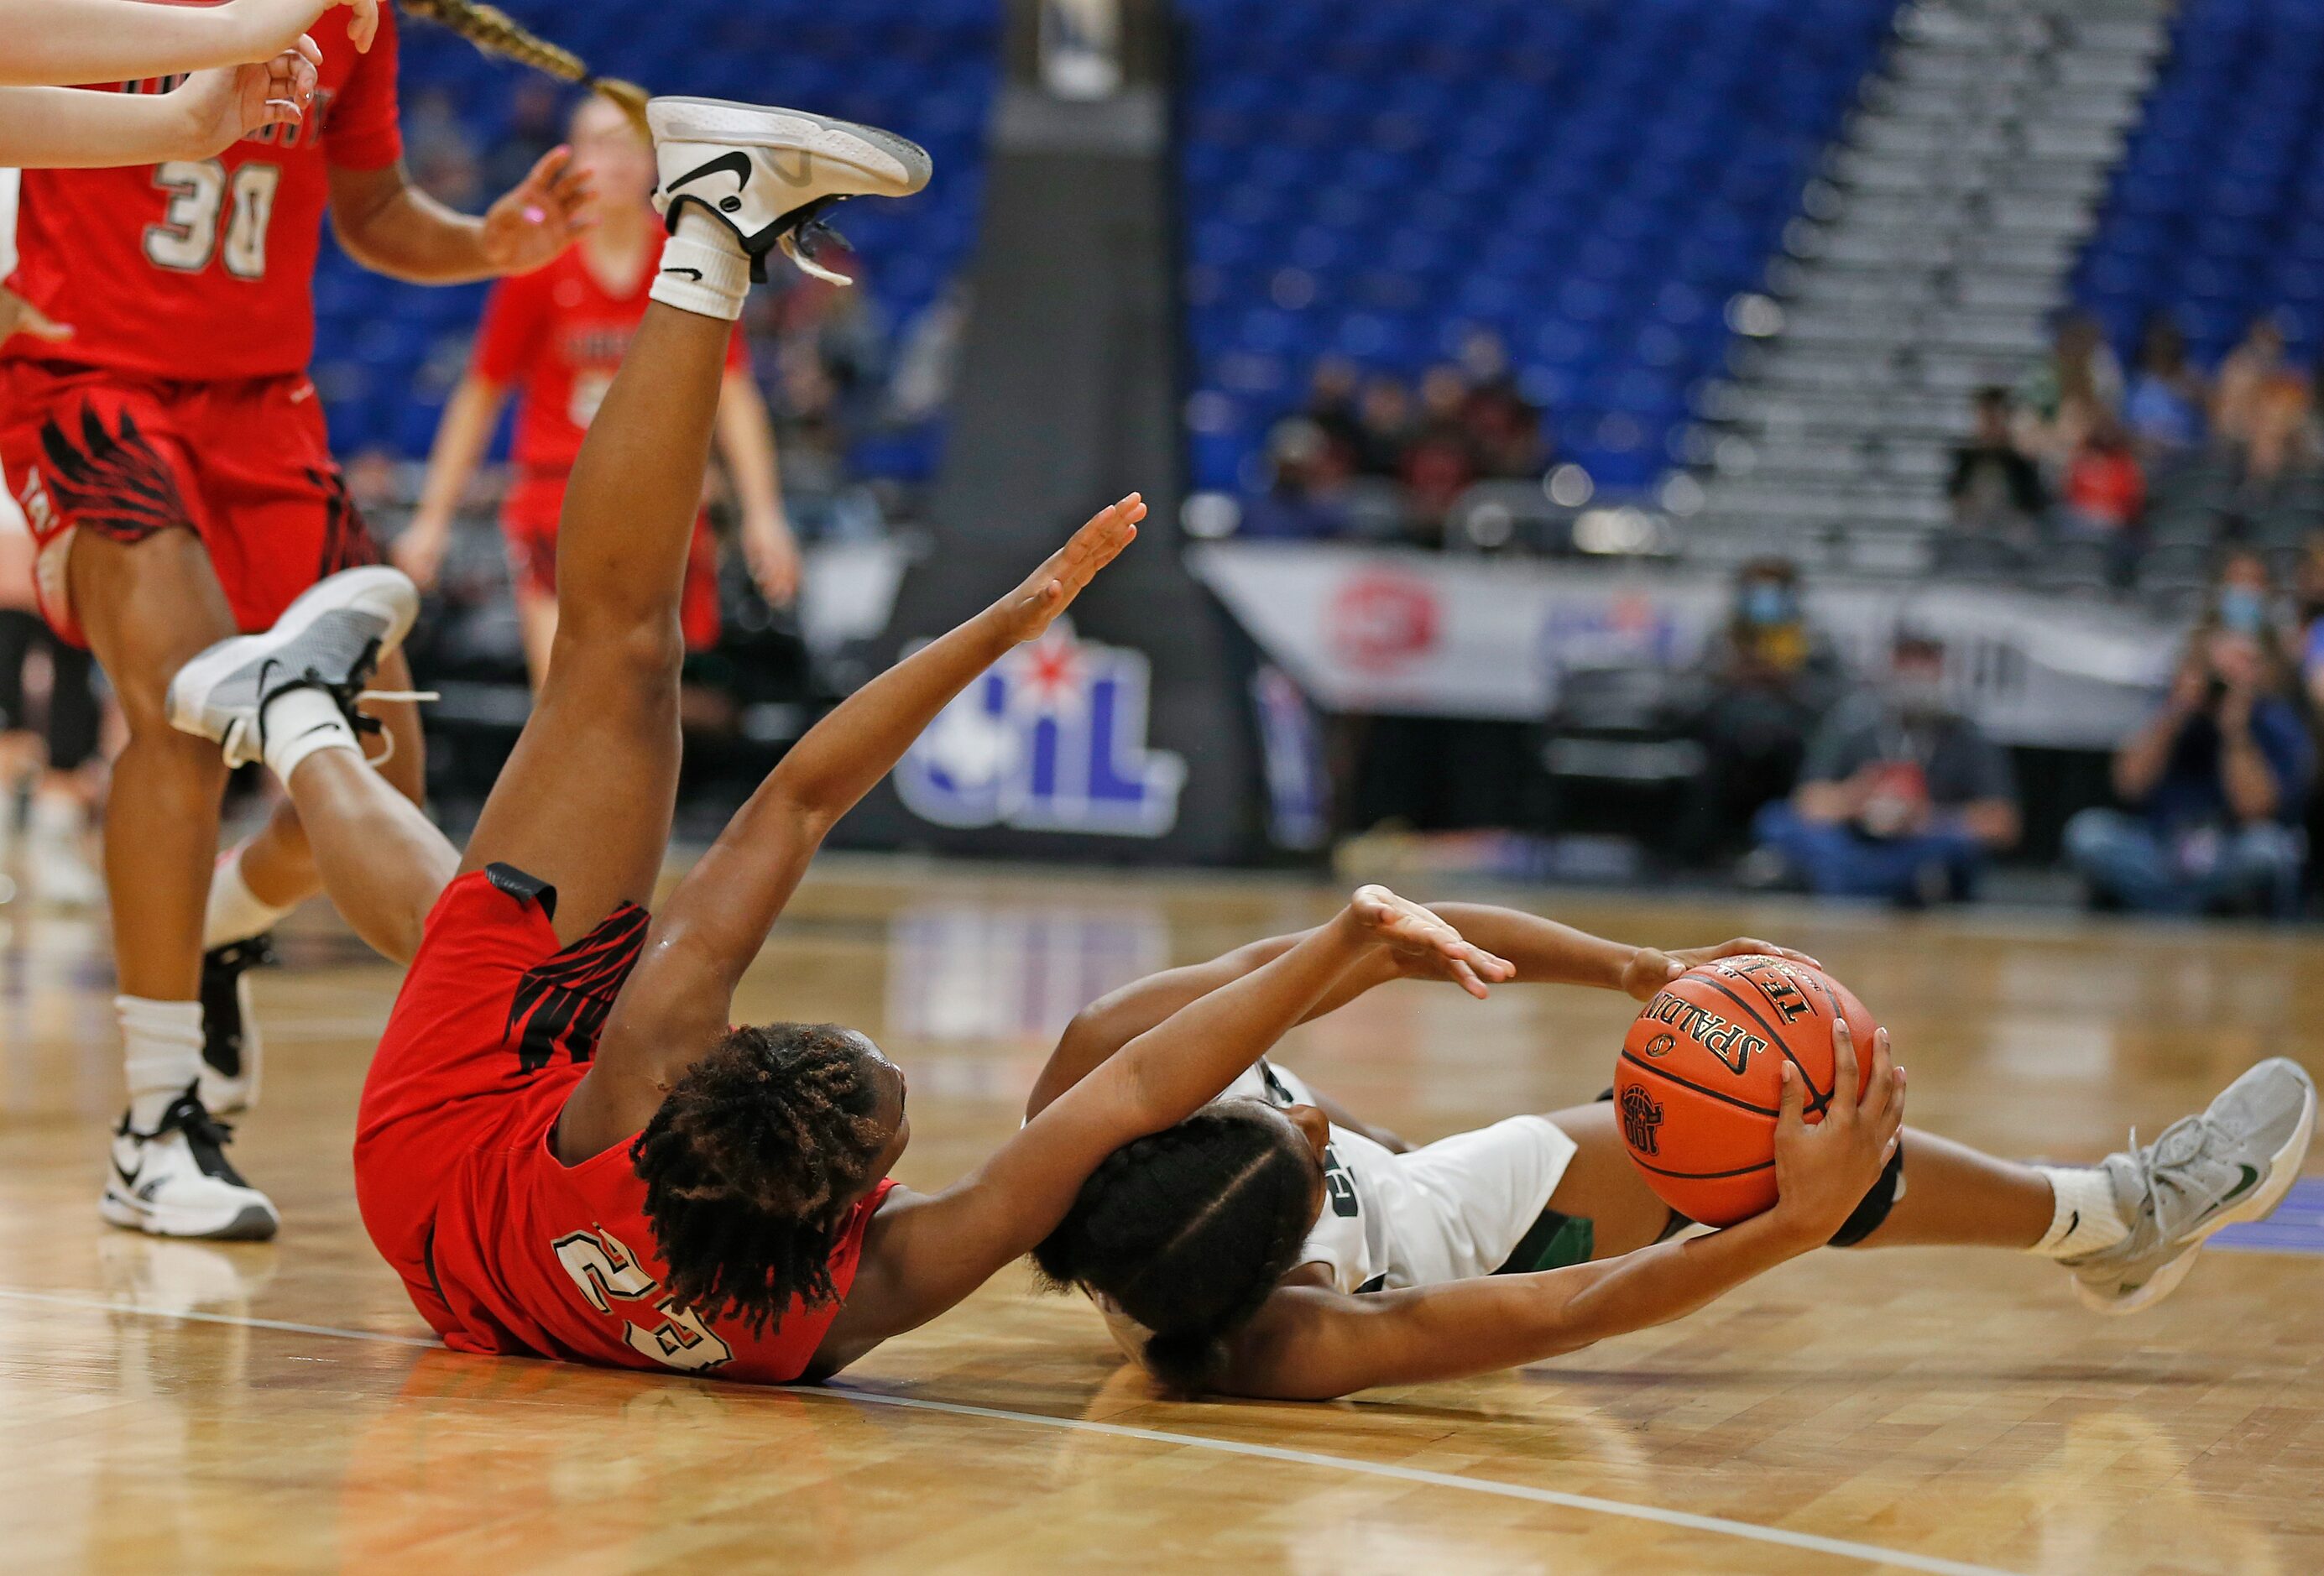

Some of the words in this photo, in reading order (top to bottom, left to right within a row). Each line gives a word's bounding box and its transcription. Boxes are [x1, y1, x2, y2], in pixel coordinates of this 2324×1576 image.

[143, 158, 281, 282] 30
[1639, 991, 1768, 1075] SPALDIN
[550, 1221, 737, 1372] 23
